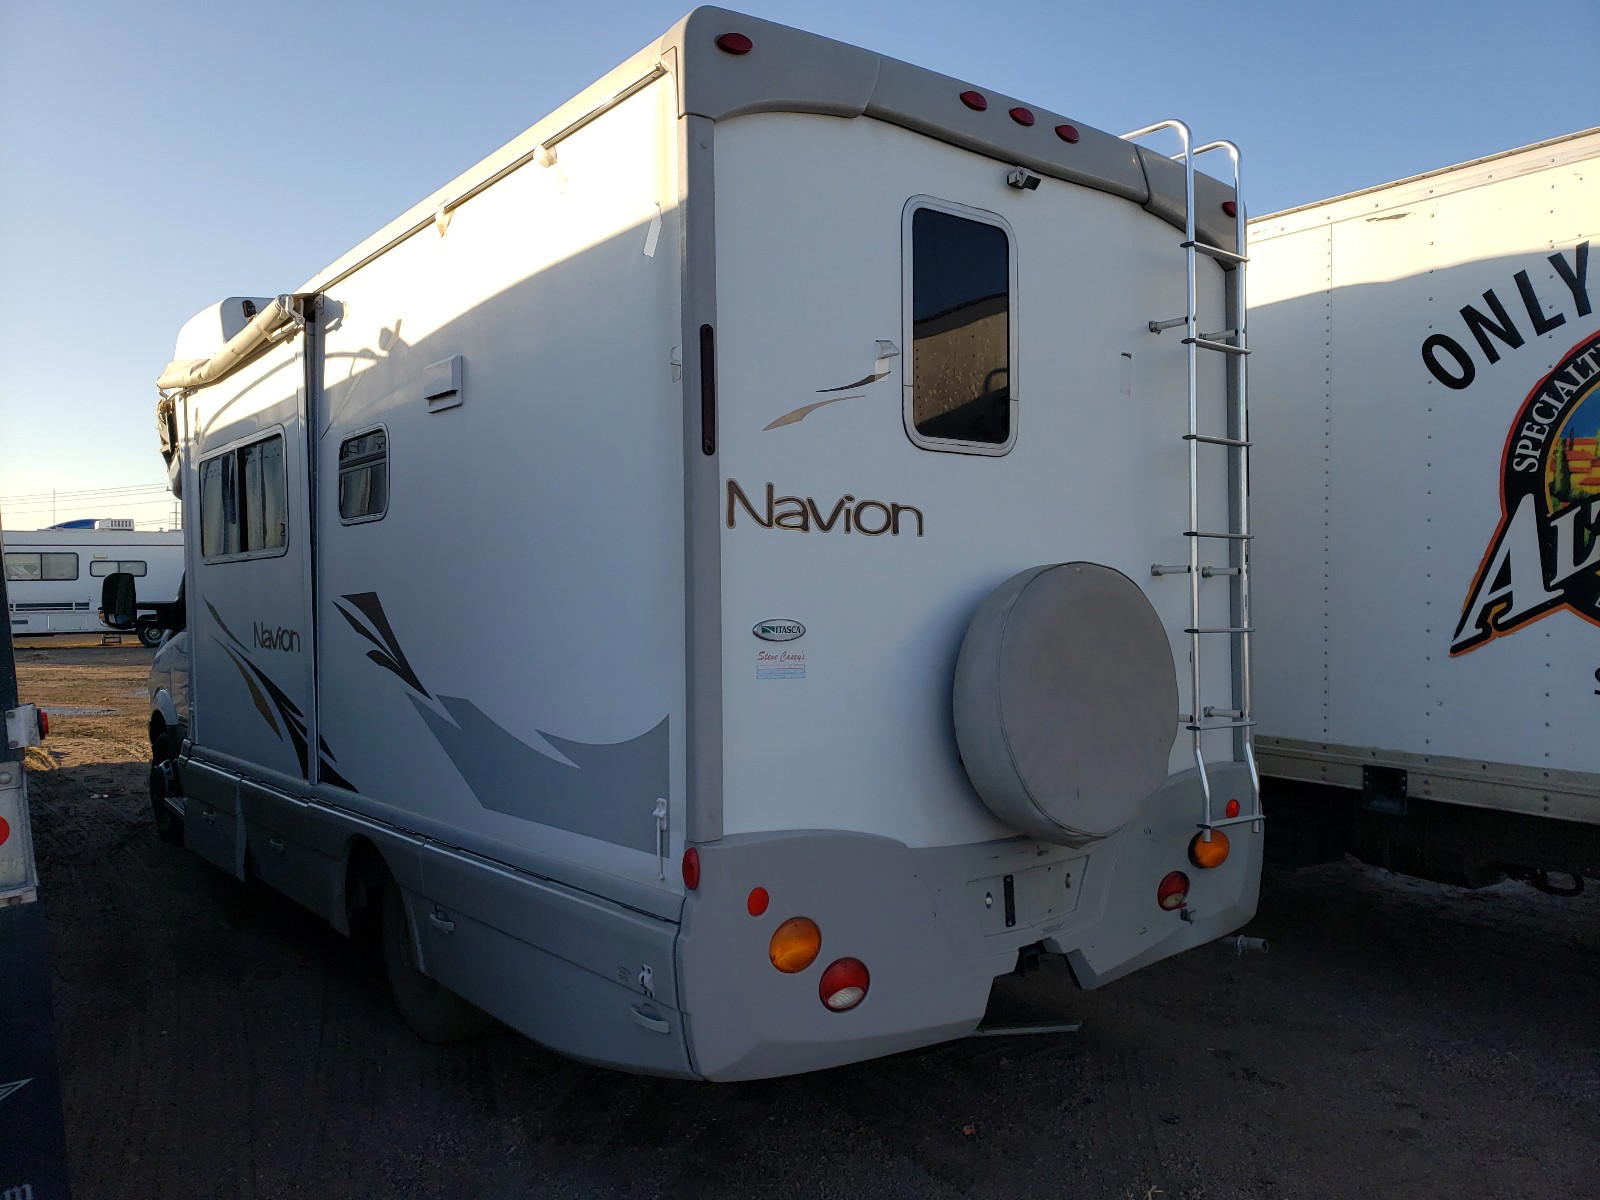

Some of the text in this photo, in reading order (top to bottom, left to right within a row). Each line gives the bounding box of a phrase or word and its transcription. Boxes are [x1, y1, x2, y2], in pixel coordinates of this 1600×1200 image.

[1422, 240, 1592, 390] ONLY
[726, 477, 924, 537] Navion
[1452, 492, 1600, 646] AL
[254, 622, 300, 652] Navion
